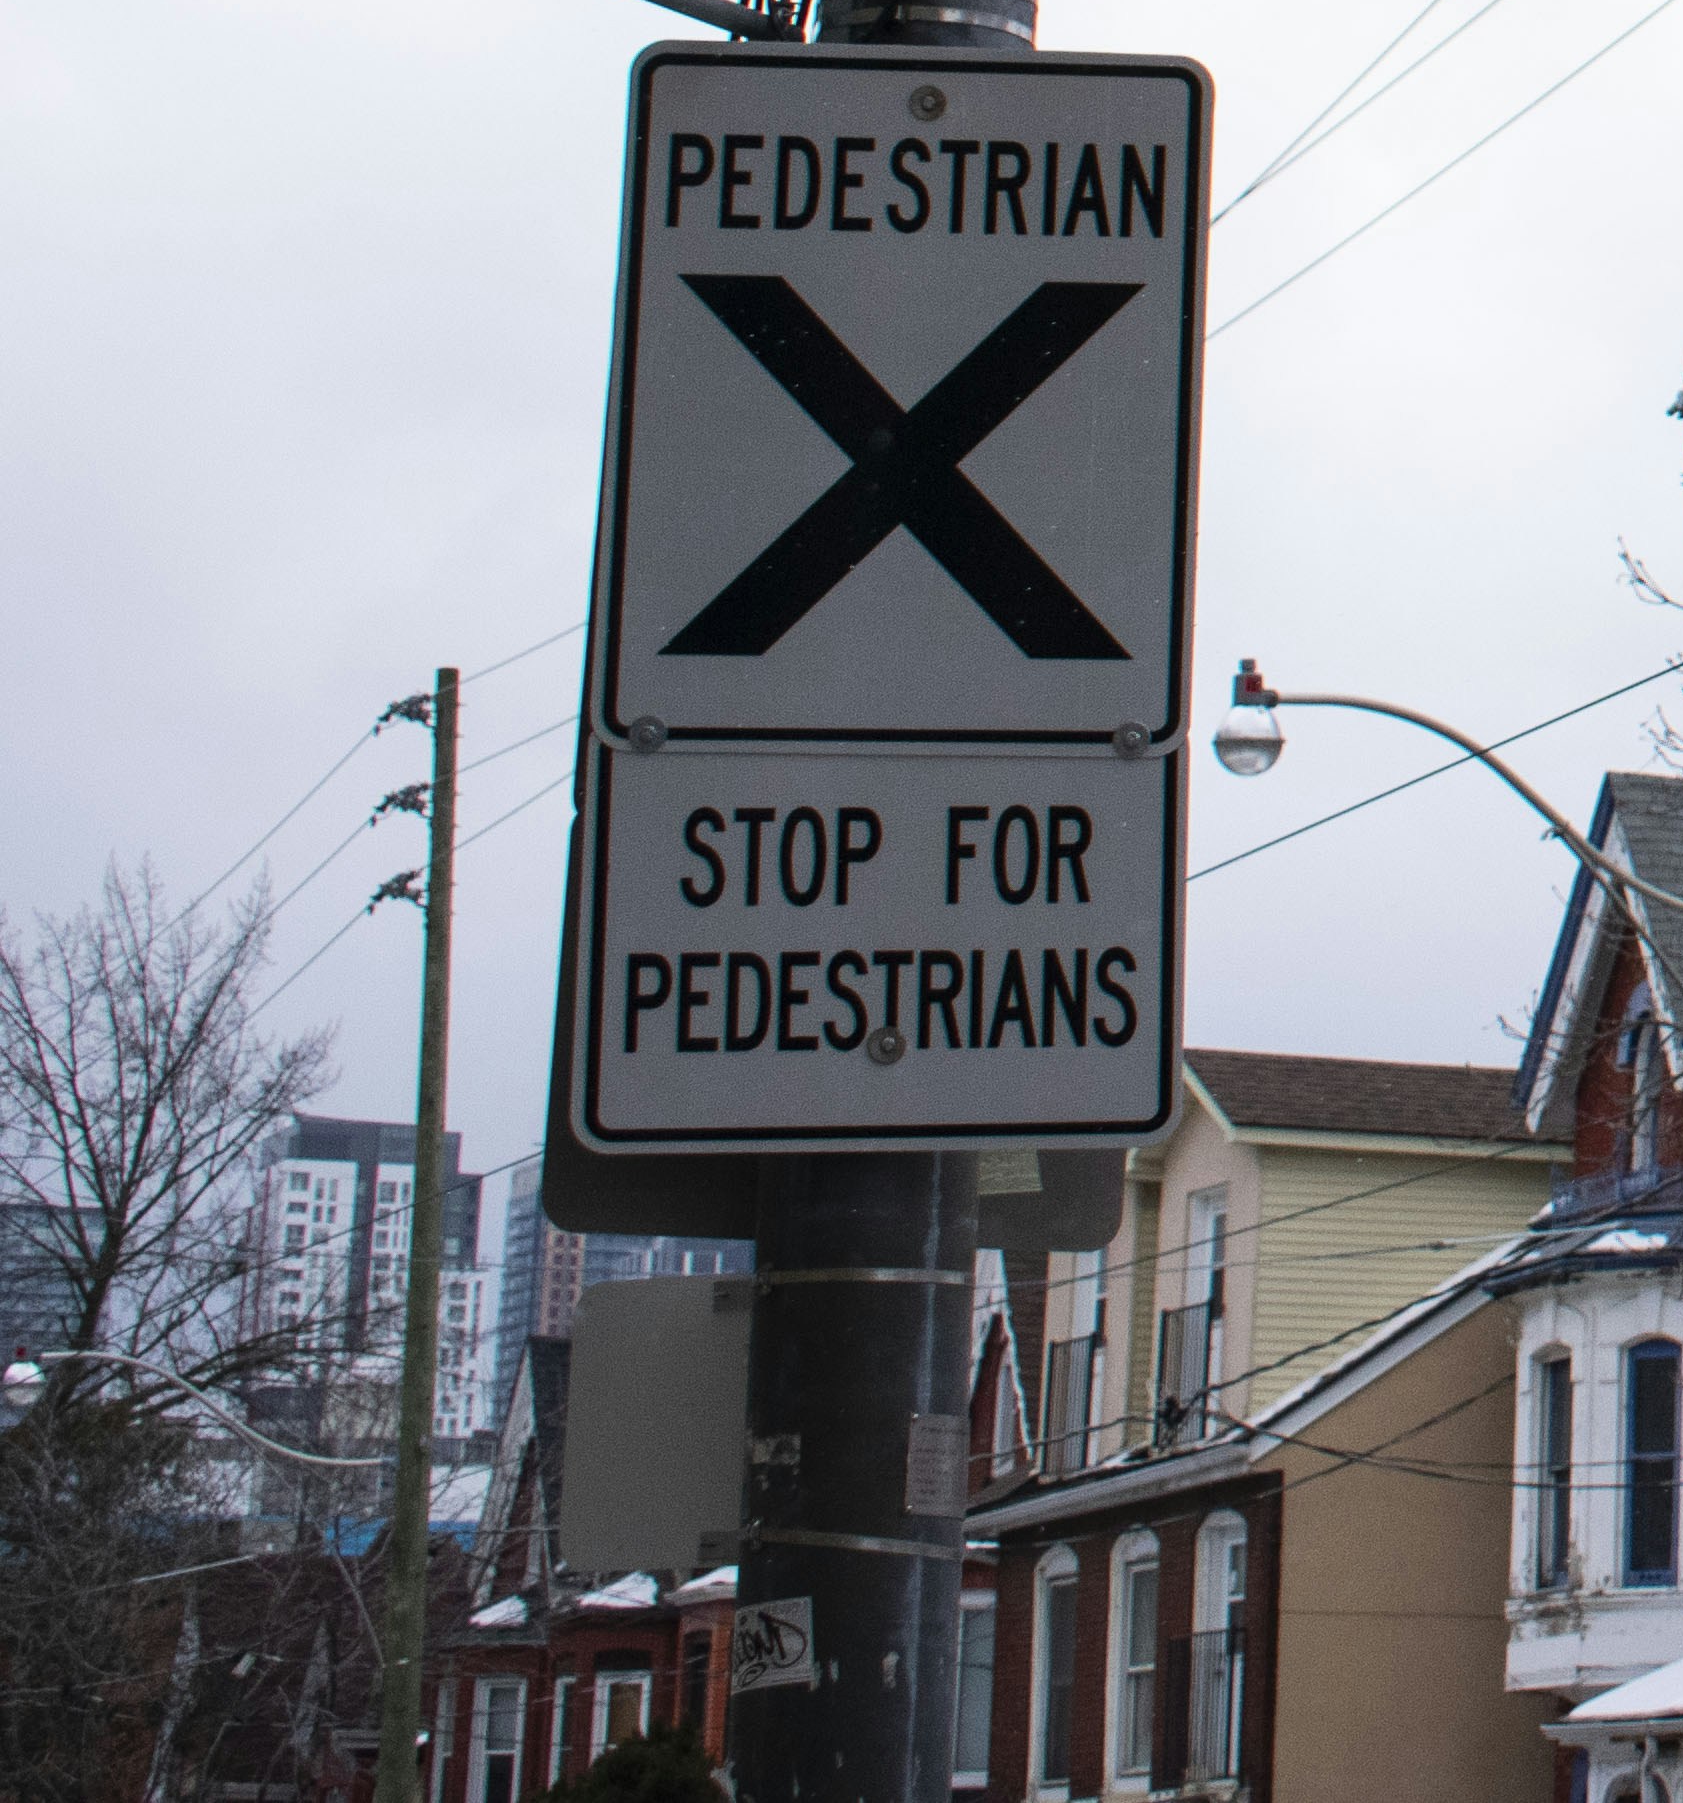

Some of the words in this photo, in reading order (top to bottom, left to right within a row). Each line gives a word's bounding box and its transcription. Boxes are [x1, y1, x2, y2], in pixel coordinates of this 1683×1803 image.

[664, 133, 1167, 239] PEDESTRIAN
[680, 805, 882, 907] STOP
[945, 805, 1093, 905] FOR
[623, 946, 1138, 1053] PEDESTRIANS
